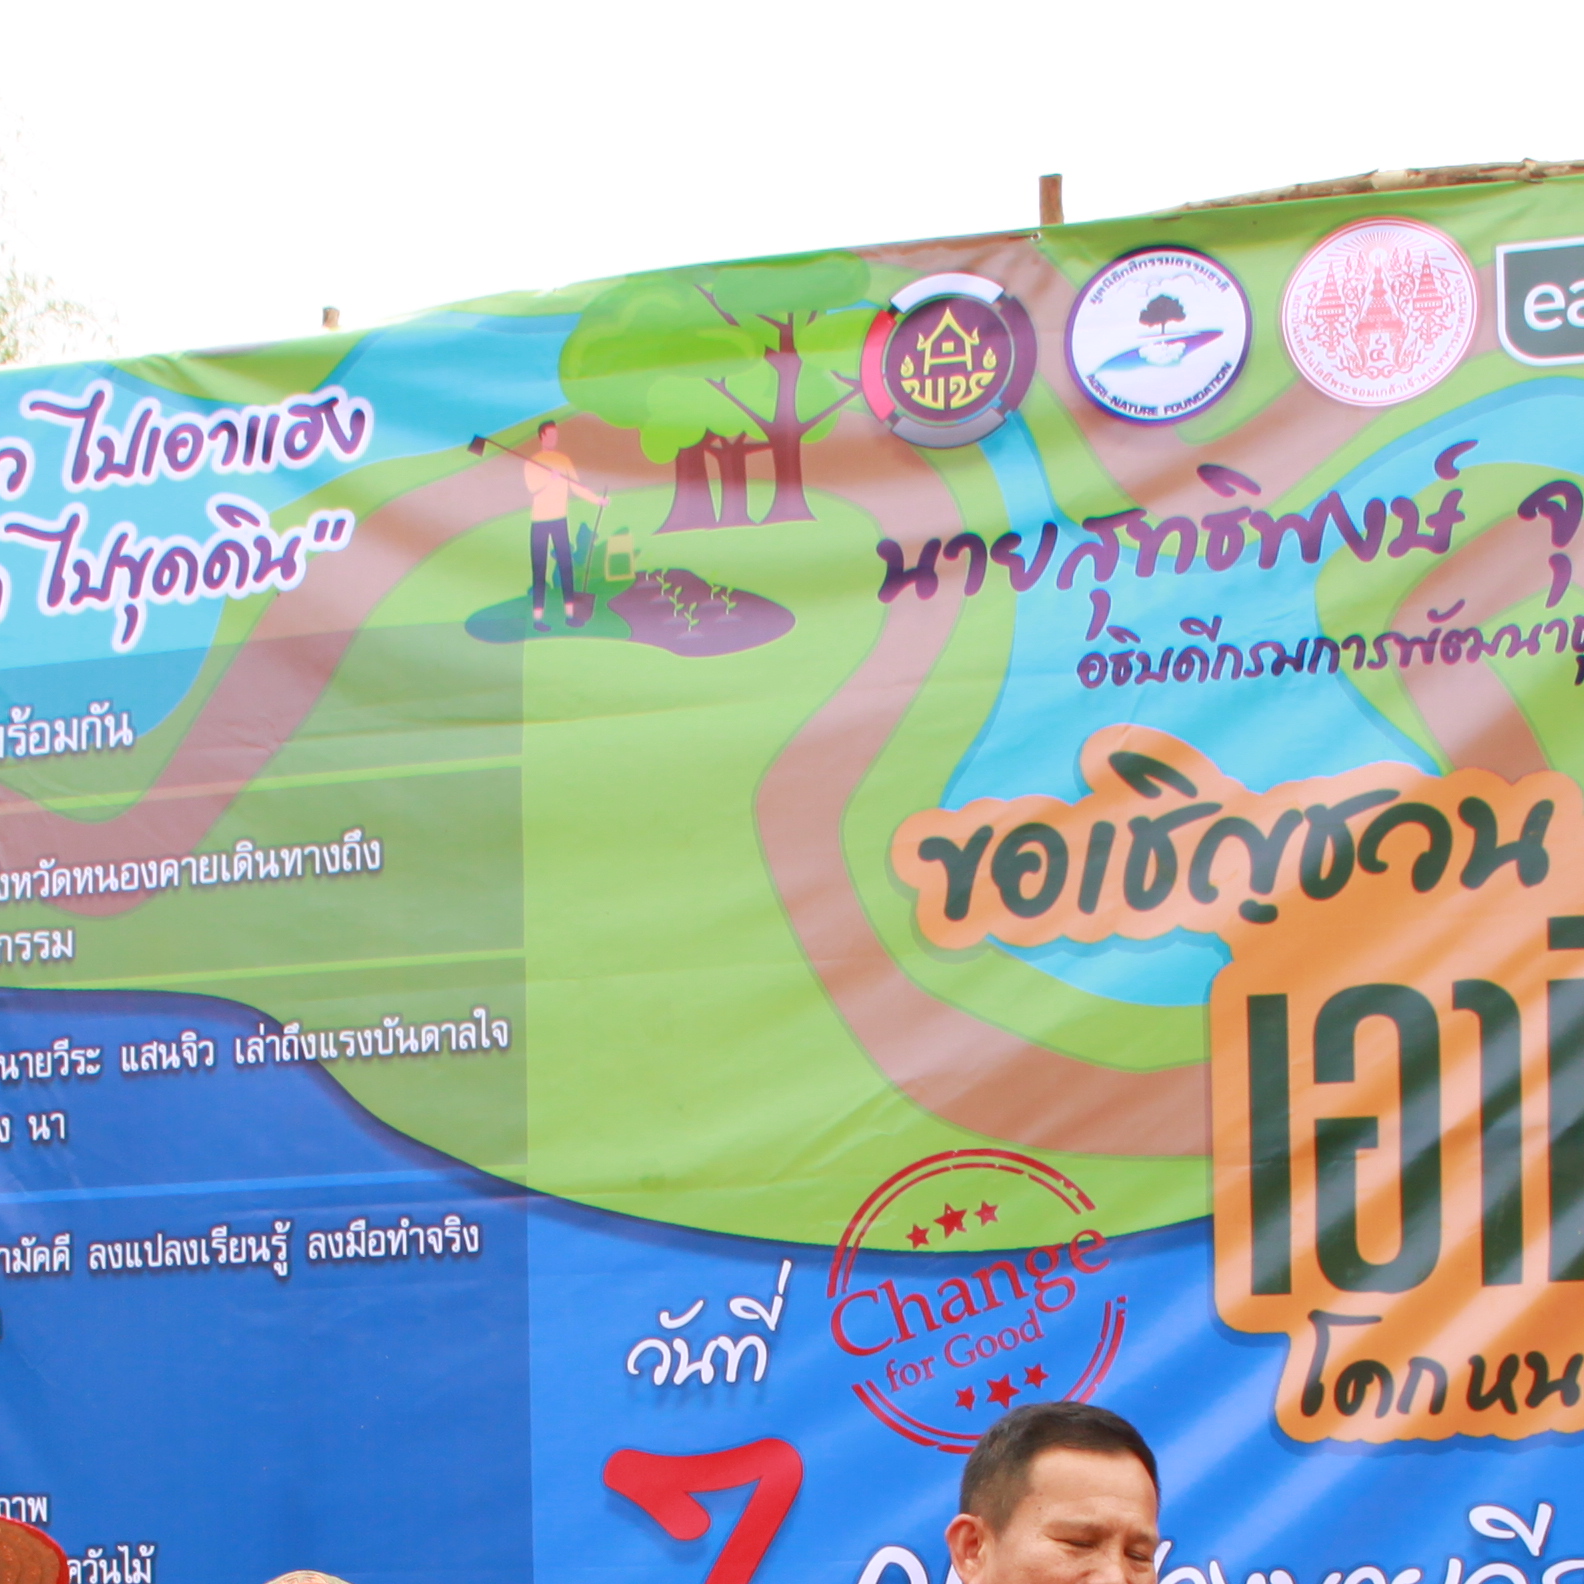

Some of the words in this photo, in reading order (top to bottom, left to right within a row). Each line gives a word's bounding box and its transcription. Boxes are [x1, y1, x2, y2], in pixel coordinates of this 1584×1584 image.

[1085, 374, 1159, 417] AGRI-NATURE
[1163, 360, 1233, 417] FOUNDATION
[918, 742, 1553, 922] ขอเชิญชวน
[234, 1008, 510, 1065] เล่าถึงแรงบันดาลใจ
[28, 1111, 67, 1142] นา
[88, 1219, 291, 1276] ลงแปลงเรียนรู้
[307, 1214, 479, 1262] ลงมือทำจริง
[626, 1259, 792, 1386] วันที่
[829, 1227, 1111, 1358] Change
[885, 1352, 937, 1394] for
[942, 1309, 1046, 1370] Good
